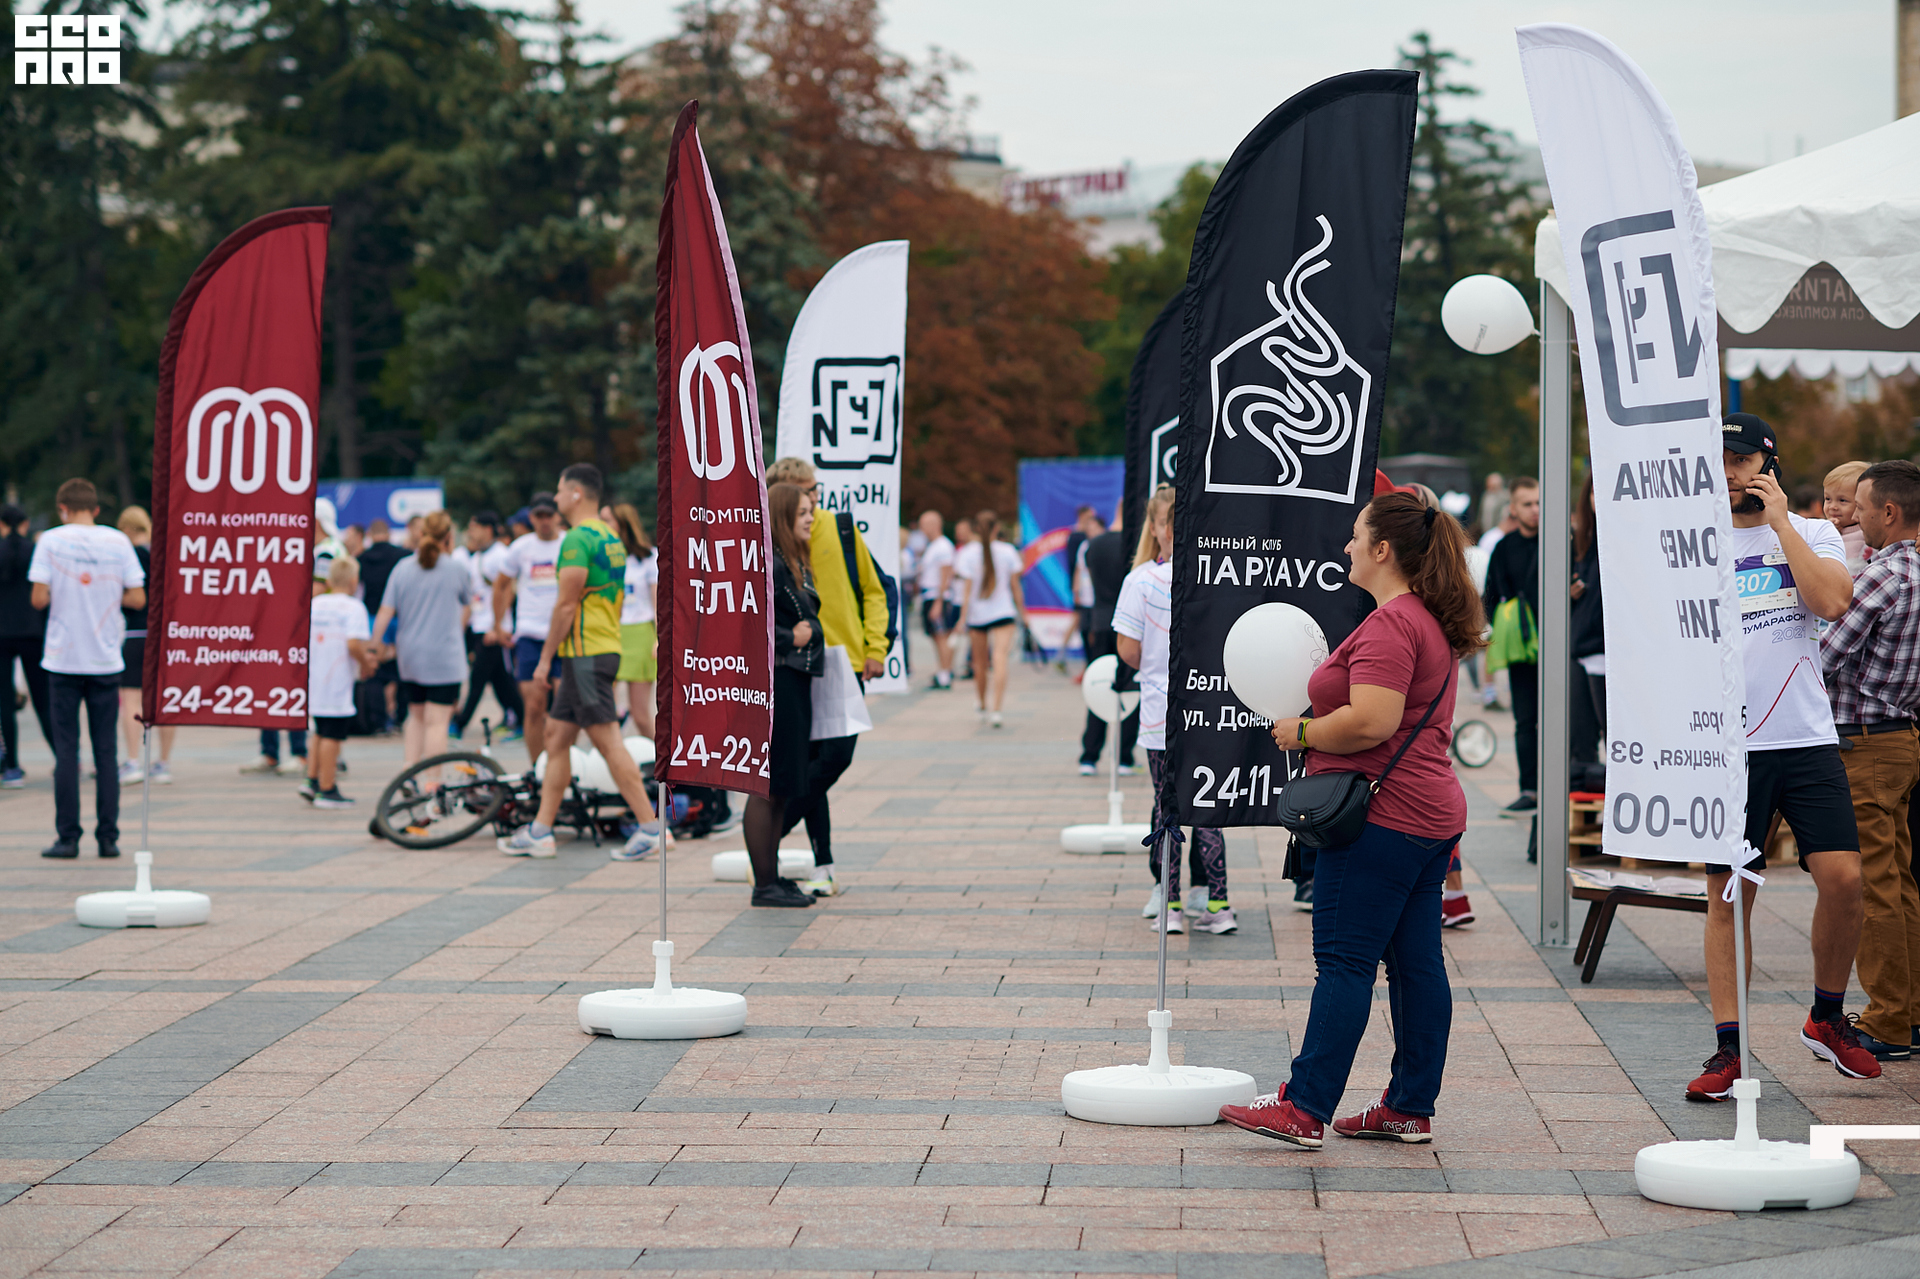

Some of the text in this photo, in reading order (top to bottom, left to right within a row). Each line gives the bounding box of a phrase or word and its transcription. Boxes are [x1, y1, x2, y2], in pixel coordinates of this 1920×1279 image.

[182, 512, 309, 529] СПА КОМПЛЕКС
[179, 535, 306, 565] МАГИЯ
[1197, 536, 1283, 551] БАННЫЙ КЛУБ
[178, 567, 275, 595] ТЕЛА
[1196, 554, 1346, 592] ПАРХАУС
[167, 621, 254, 643] Белгород,
[166, 646, 307, 666] ул. Донецкая, 93
[162, 685, 306, 717] 24-22-22
[1183, 709, 1211, 731] ул.
